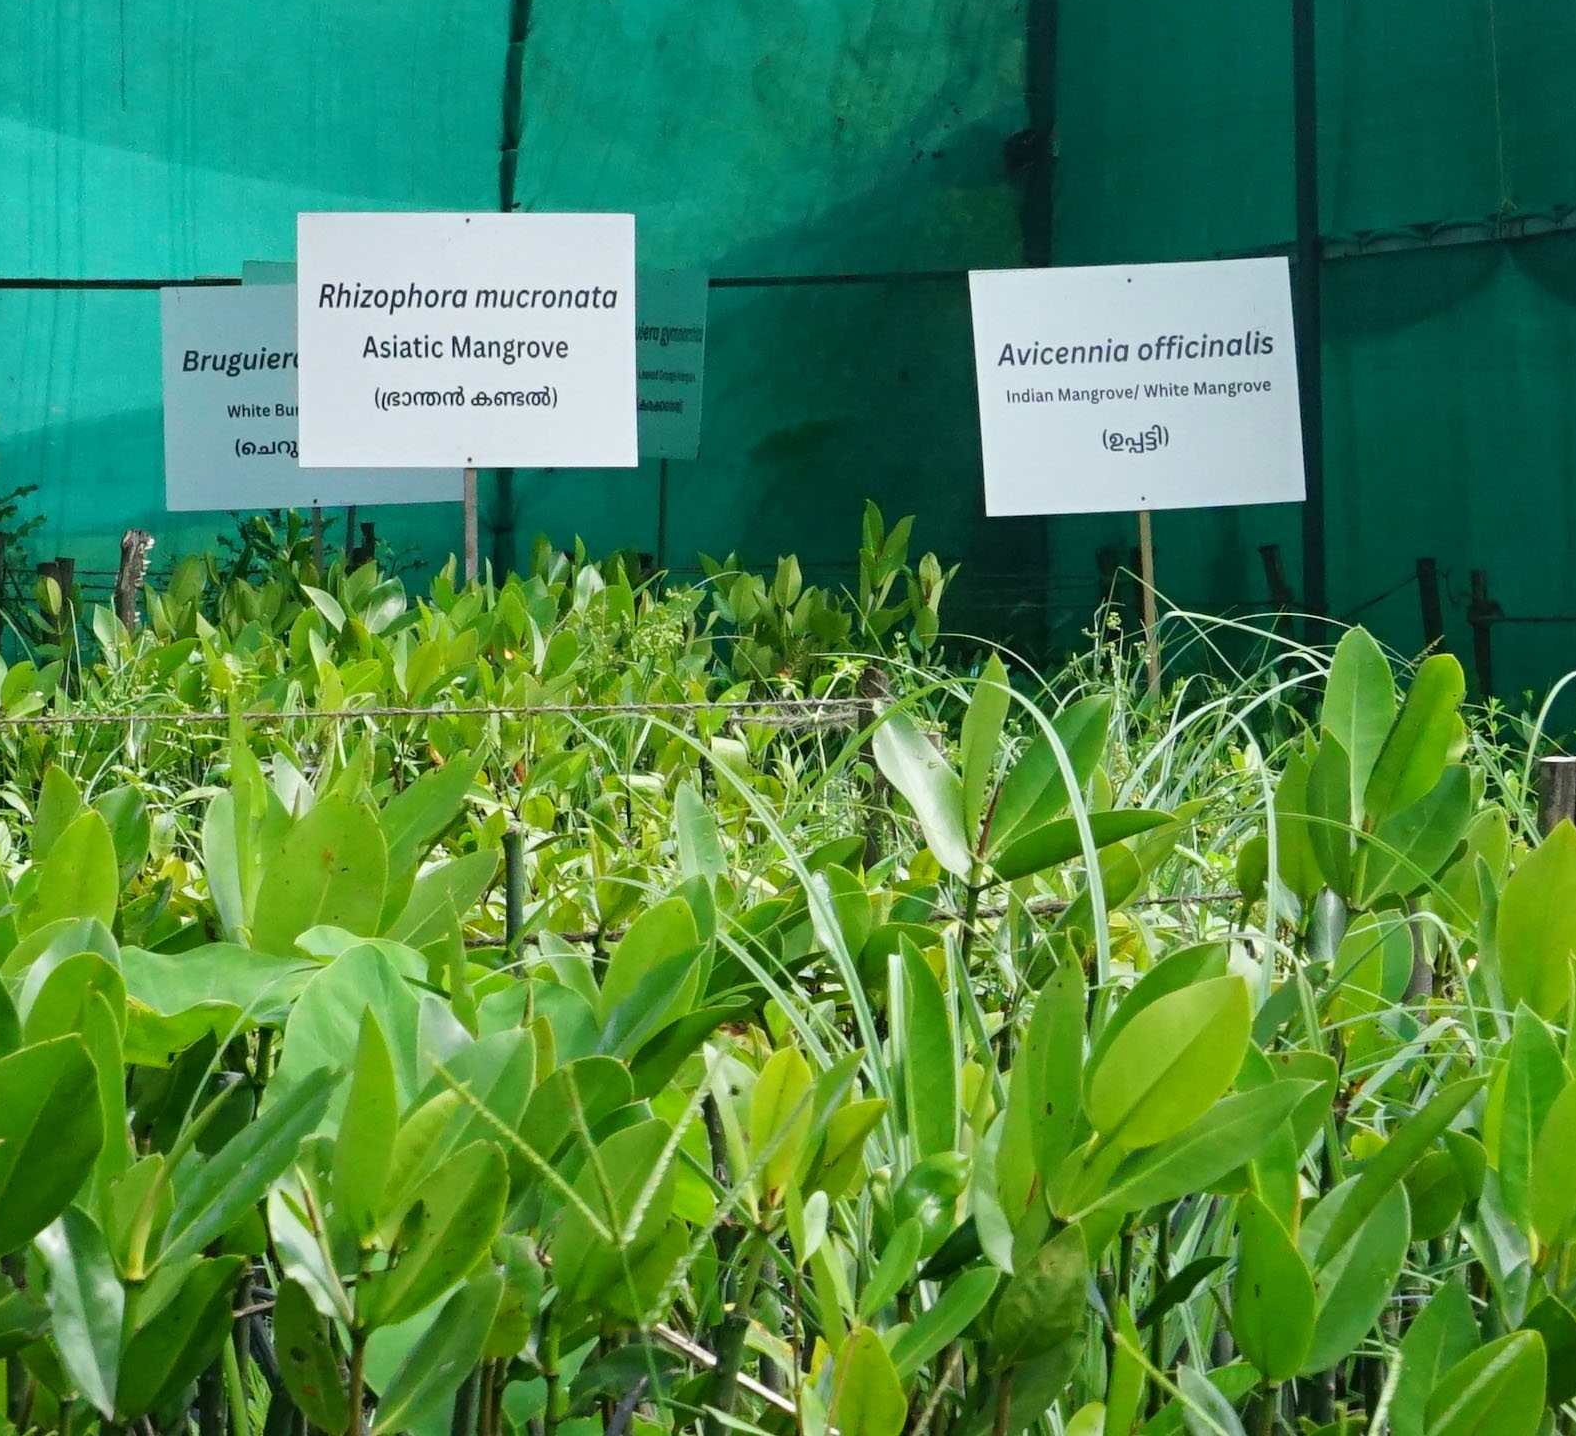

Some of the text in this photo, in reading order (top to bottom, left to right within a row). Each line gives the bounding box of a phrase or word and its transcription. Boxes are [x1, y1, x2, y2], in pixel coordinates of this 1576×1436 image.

[318, 283, 618, 315] Rhizophora mucronata
[362, 335, 569, 364] Asiatic Mangrove
[998, 331, 1274, 367] Avicennia officinalis
[1006, 379, 1272, 404] Indian Mangrove/ White Mangrove
[227, 404, 270, 418] White
